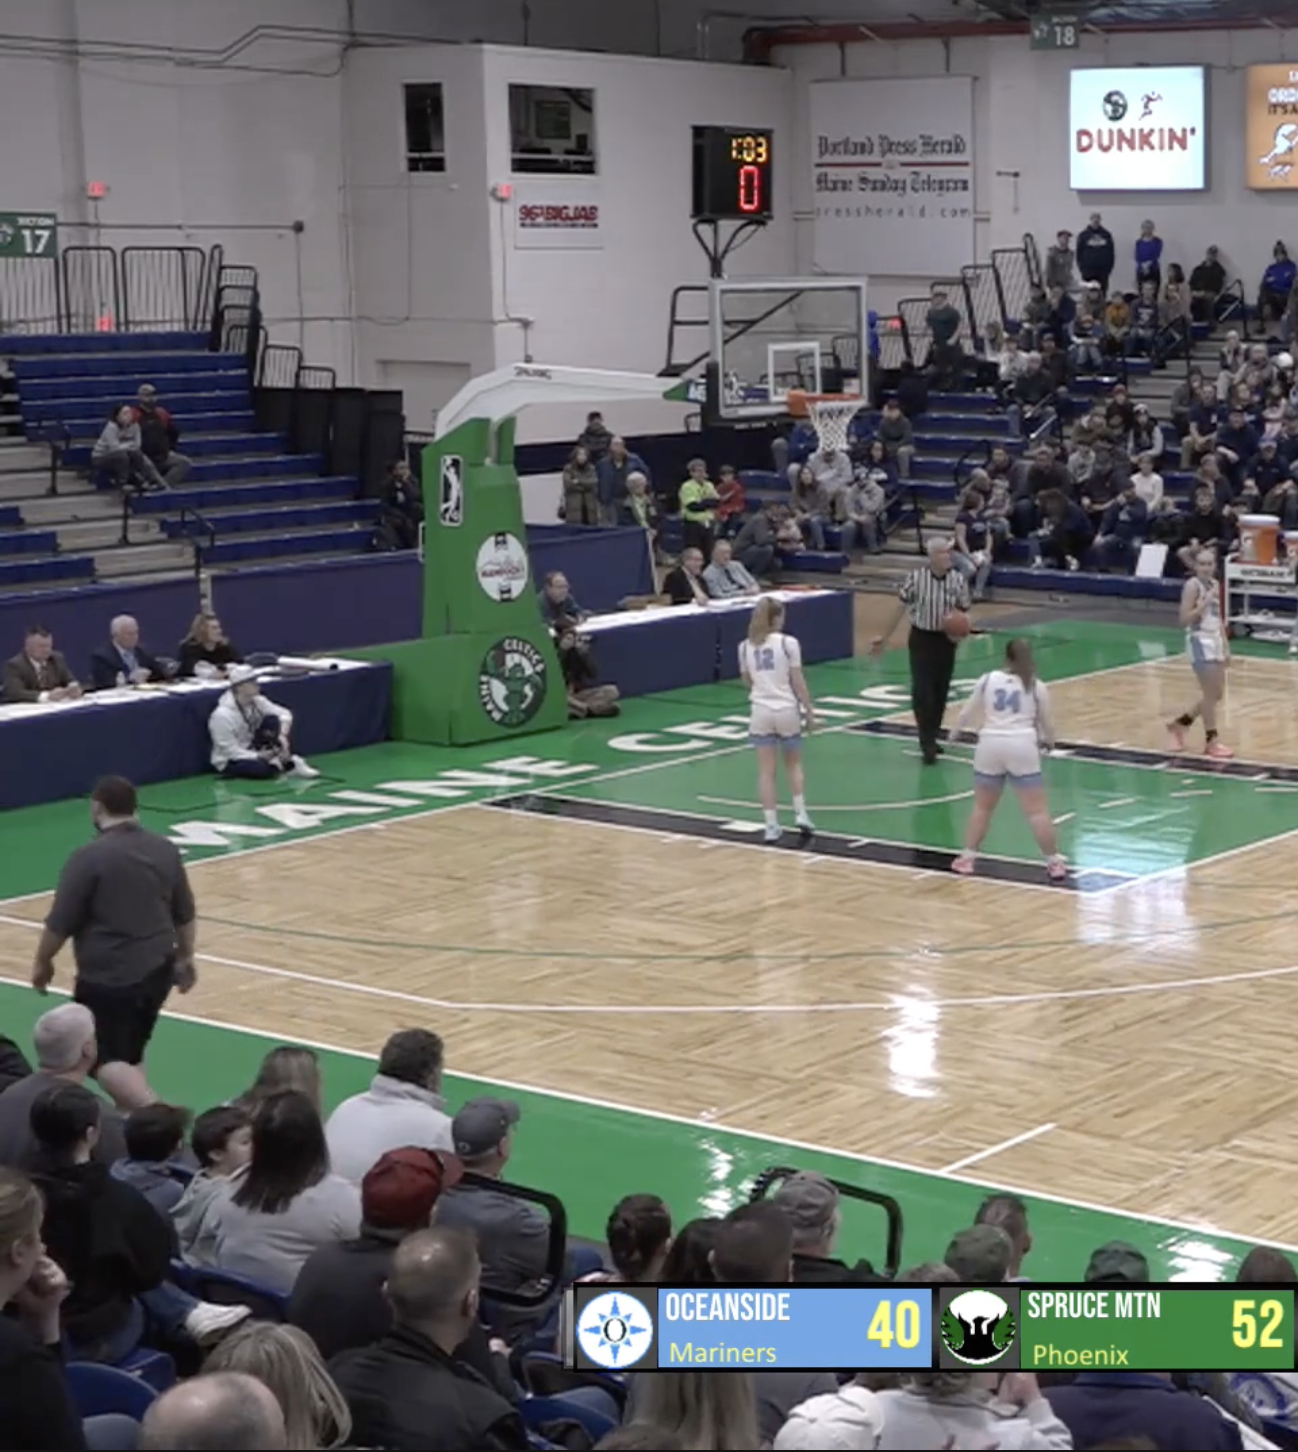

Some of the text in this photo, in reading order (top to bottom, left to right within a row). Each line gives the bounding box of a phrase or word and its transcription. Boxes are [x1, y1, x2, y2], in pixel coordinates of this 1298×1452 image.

[1053, 25, 1076, 46] 18
[731, 136, 767, 162] 1:03
[817, 133, 967, 158] Portland Press Herald
[1076, 125, 1197, 153] DUNKIN'
[739, 165, 759, 210] 0
[815, 170, 970, 197] Maine Sunday Telegram
[21, 229, 52, 254] 17
[503, 638, 545, 673] CELTICS
[753, 647, 775, 671] 12
[993, 688, 1023, 714] 34
[166, 756, 600, 854] MAINE
